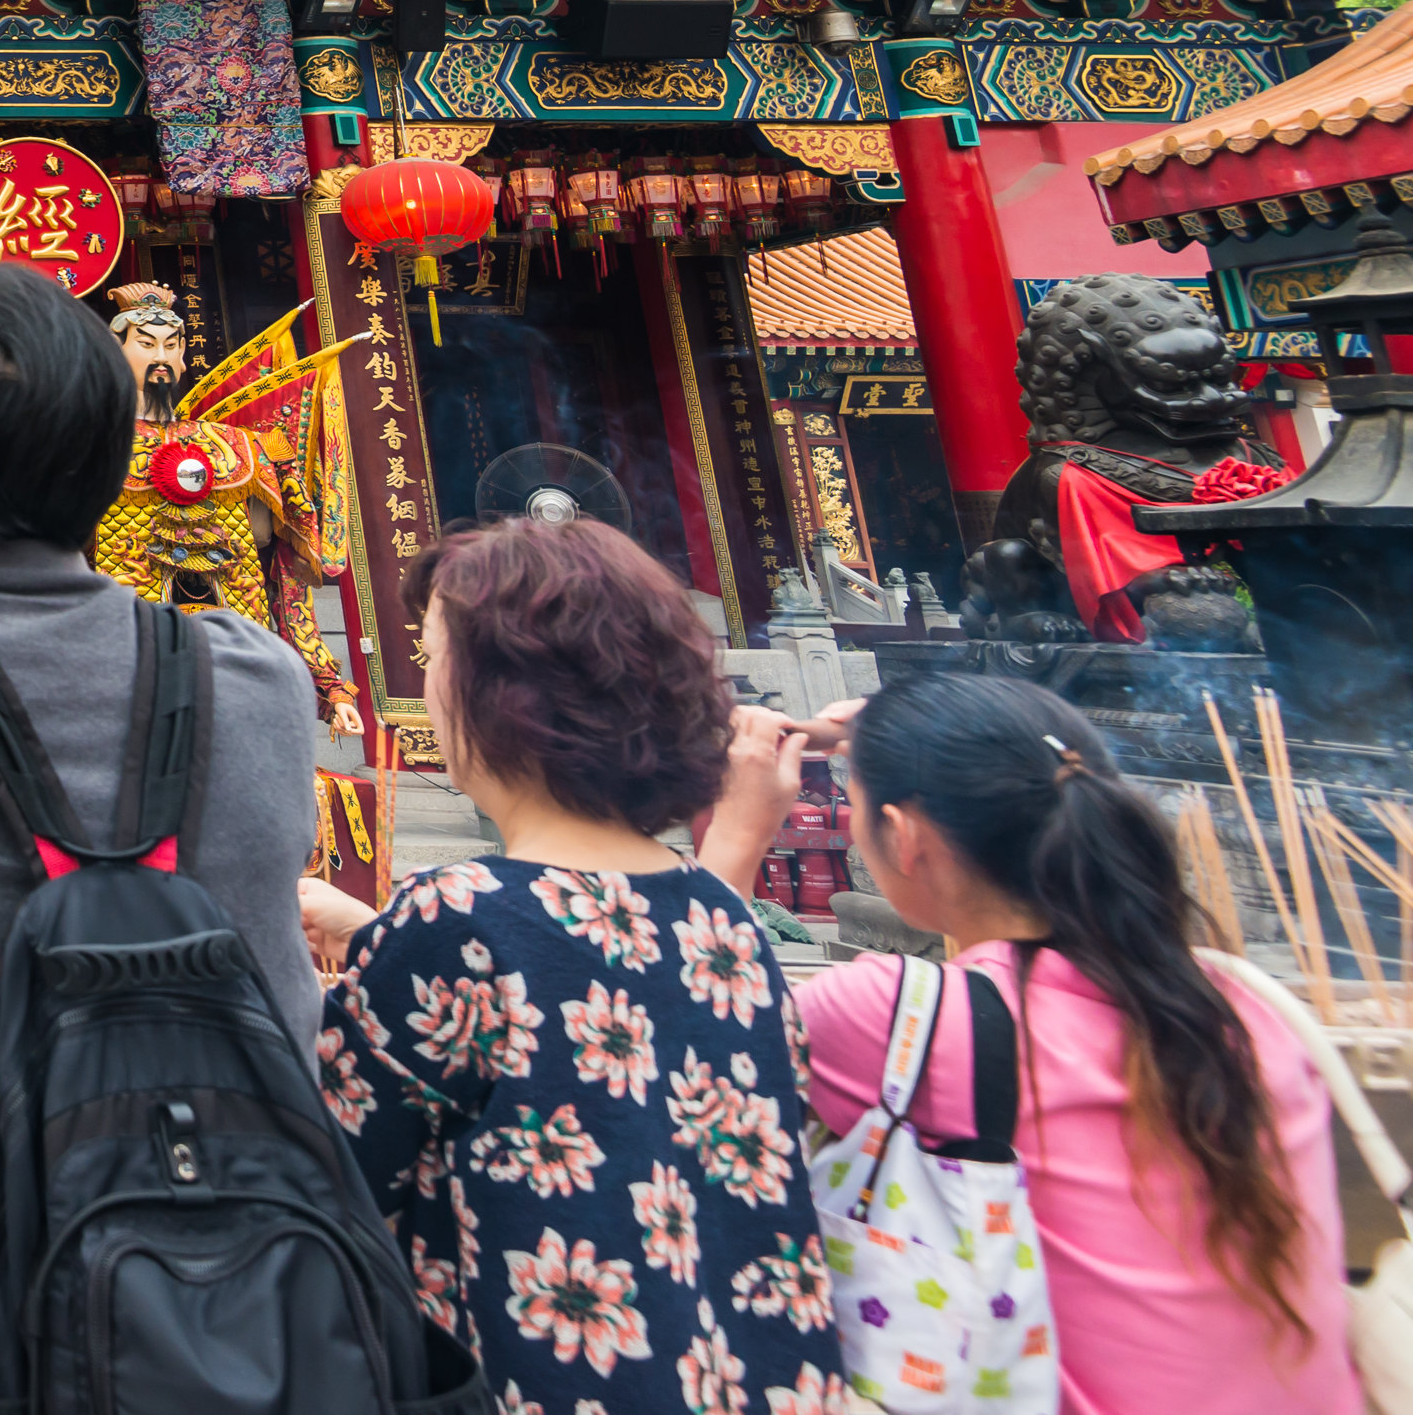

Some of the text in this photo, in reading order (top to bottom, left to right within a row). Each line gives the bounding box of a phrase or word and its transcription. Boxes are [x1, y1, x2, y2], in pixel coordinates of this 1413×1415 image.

[347, 240, 421, 581] 廣樂奏鈞天香篆絪緼
